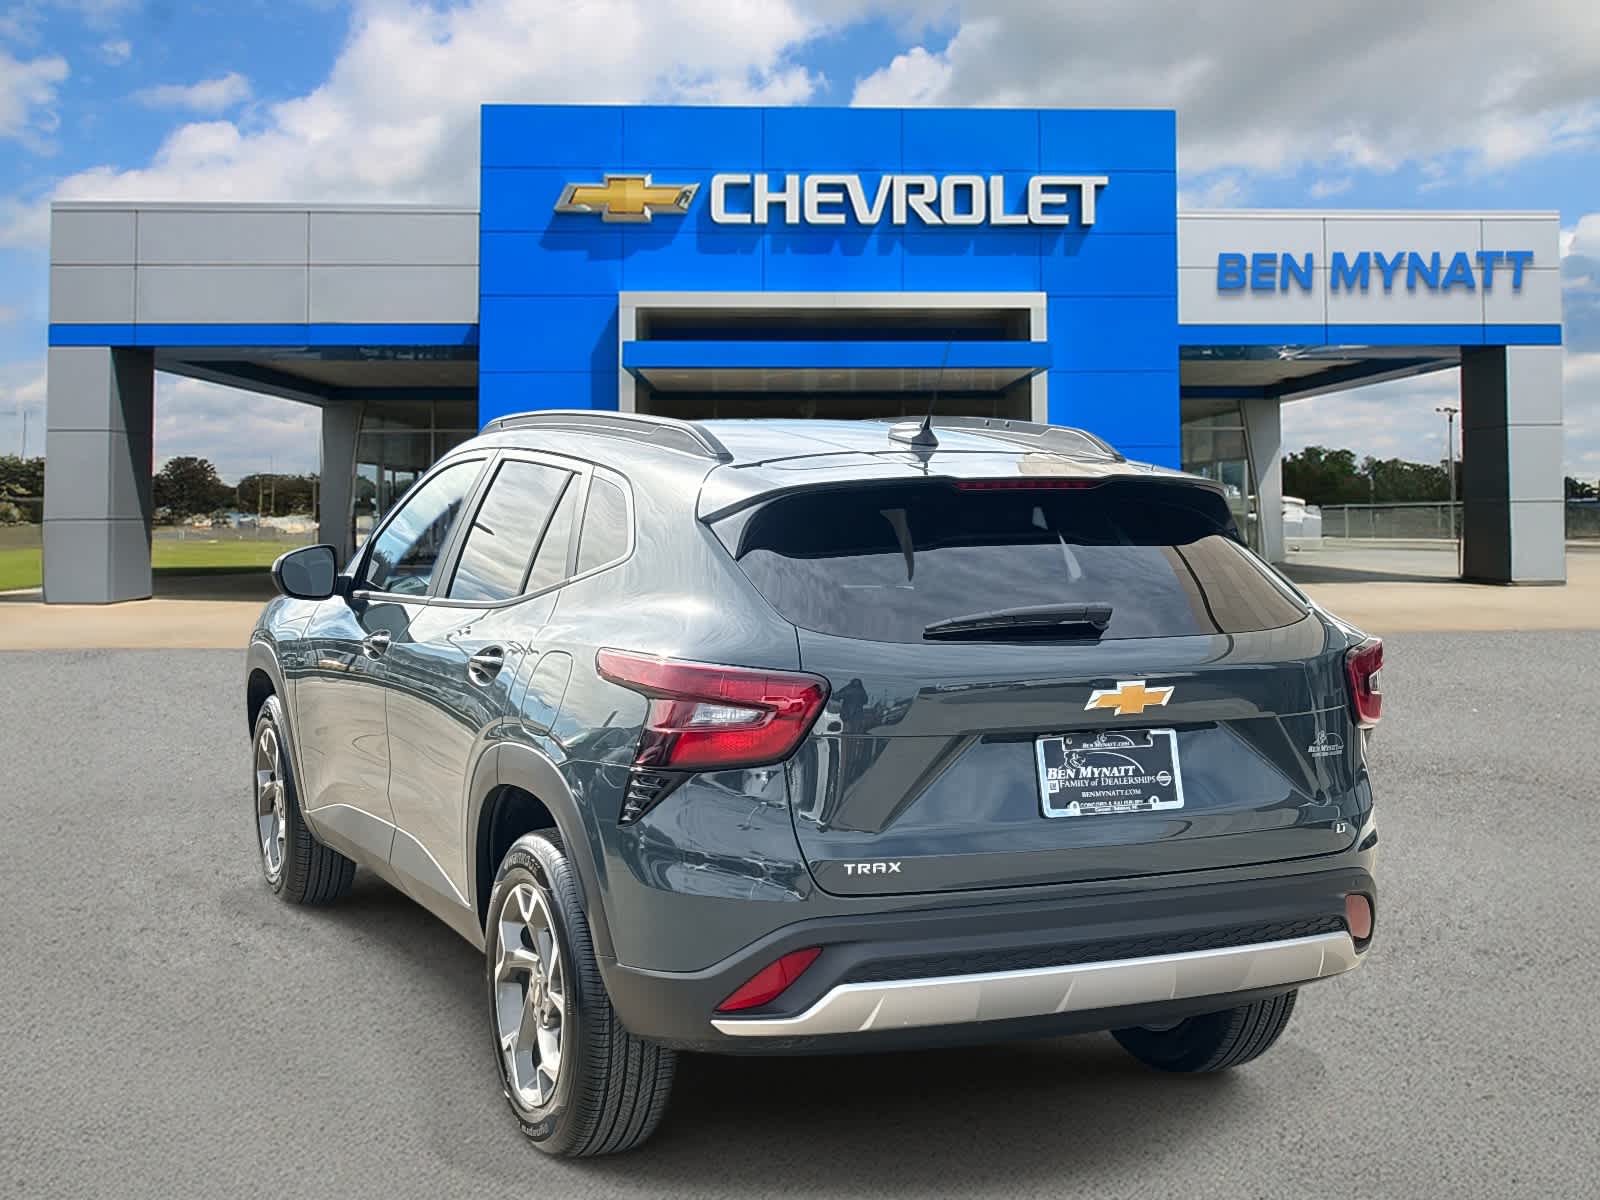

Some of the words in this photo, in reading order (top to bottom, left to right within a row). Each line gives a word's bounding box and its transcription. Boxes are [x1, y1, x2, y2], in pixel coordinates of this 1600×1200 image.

[710, 173, 1109, 225] CHEVROLET
[1217, 252, 1313, 290] BEN
[1330, 251, 1534, 290] MYNATT
[1047, 767, 1076, 780] BEN
[1079, 766, 1136, 779] MYNATT
[1060, 779, 1089, 788] FAMILY
[1101, 776, 1156, 786] DEALERSHIPS
[843, 861, 901, 876] TRAX
